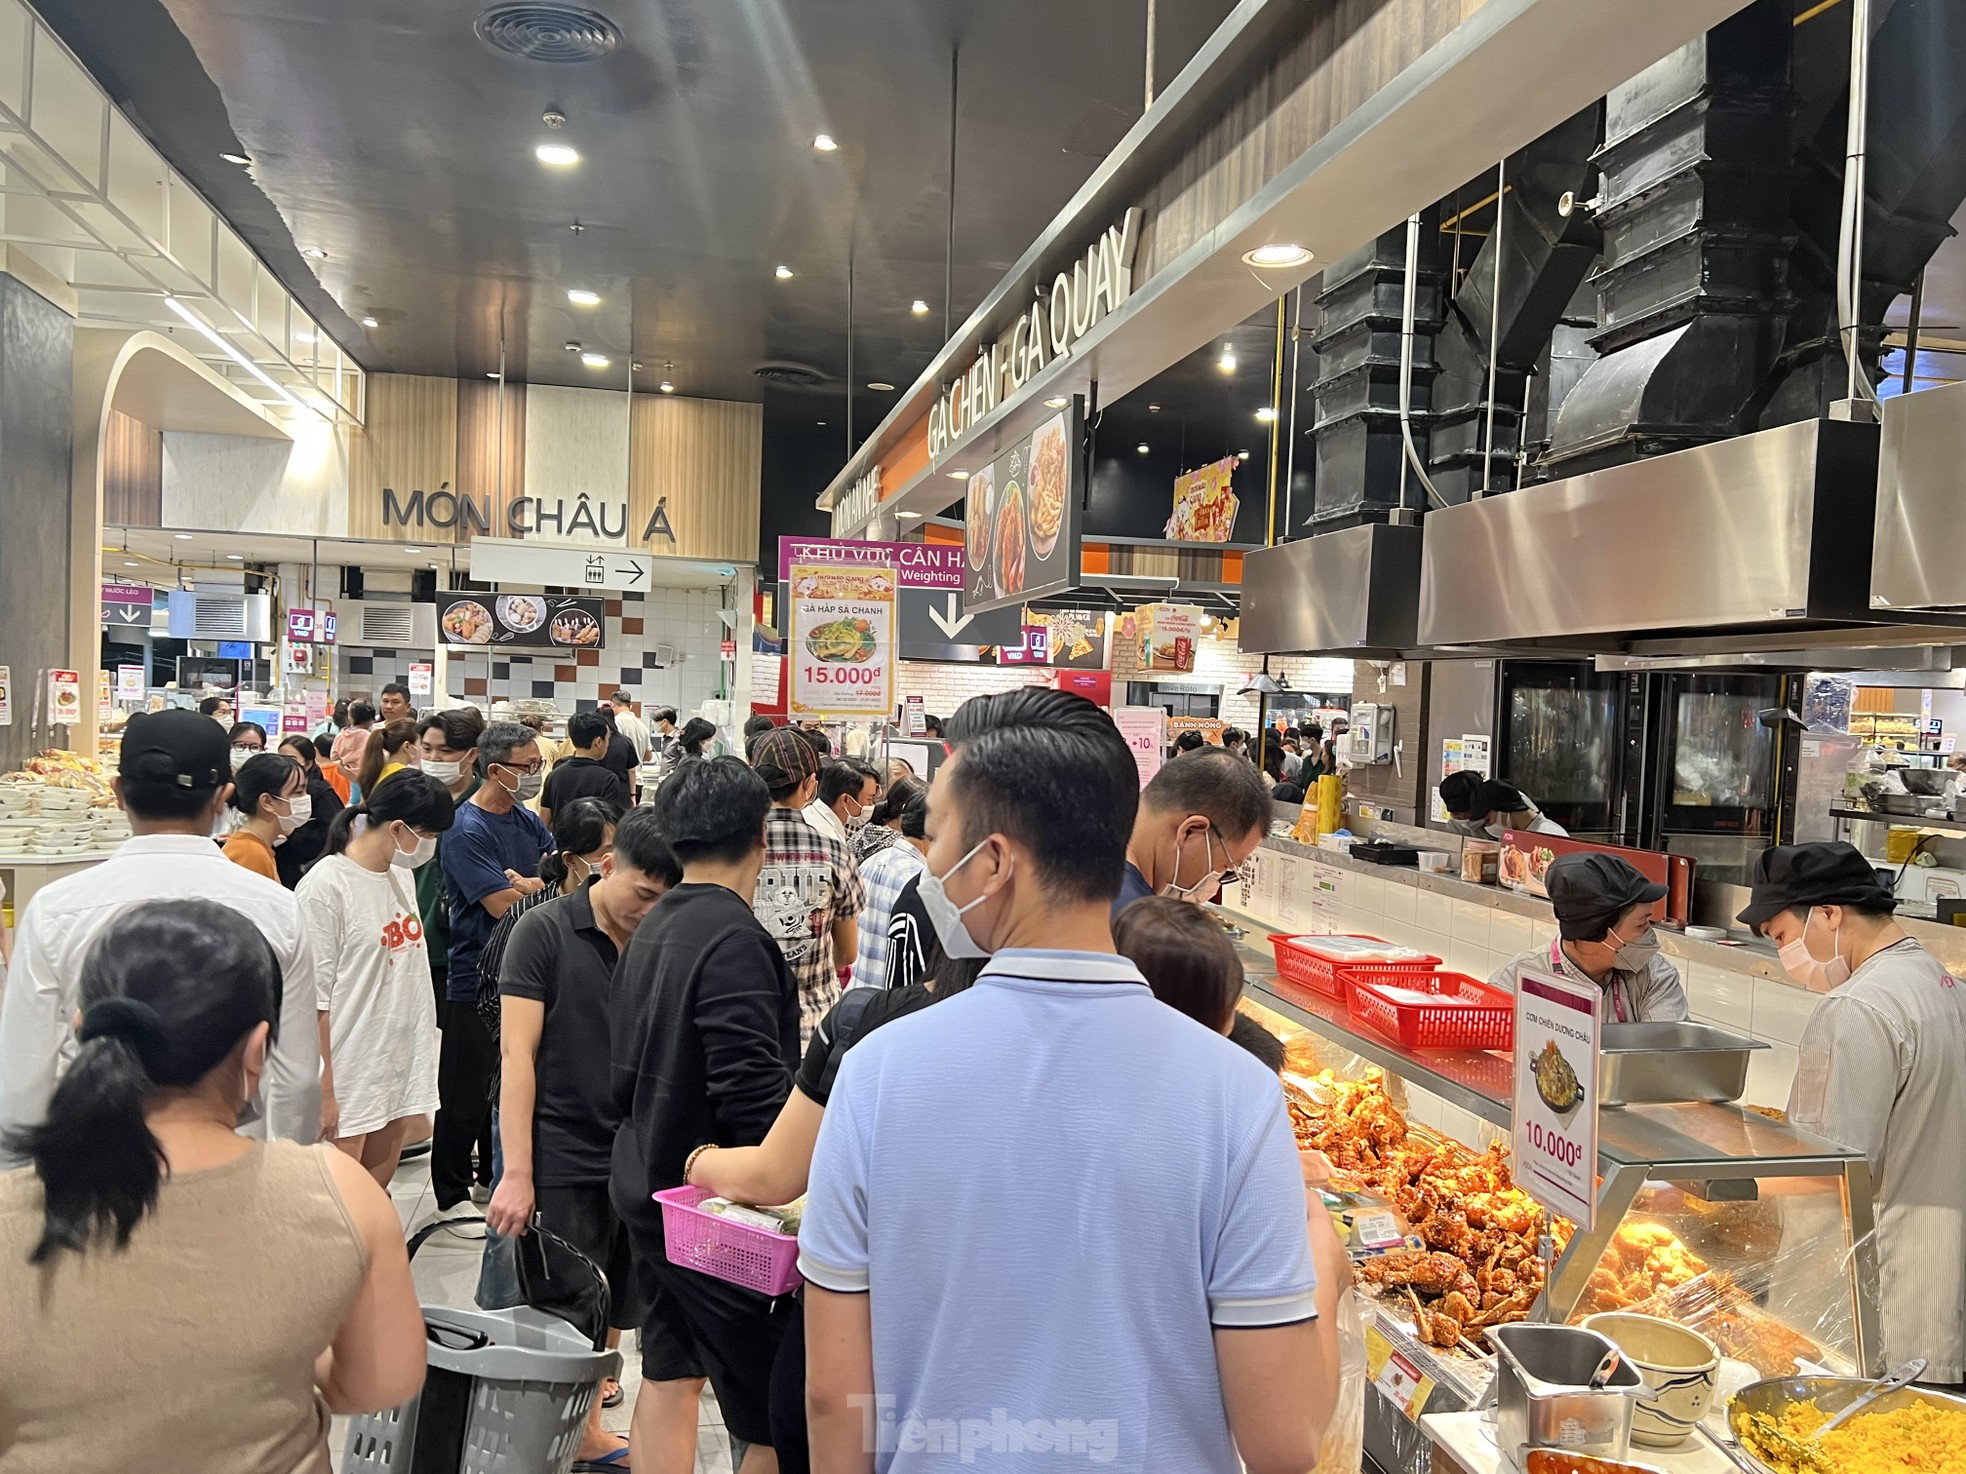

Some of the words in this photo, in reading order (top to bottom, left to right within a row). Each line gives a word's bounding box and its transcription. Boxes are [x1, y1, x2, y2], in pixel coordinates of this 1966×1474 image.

[1011, 285, 1050, 389] GÀ
[1050, 206, 1142, 360] QUAY
[382, 482, 491, 529] MÓN
[507, 492, 627, 539] CHÂU
[643, 496, 677, 543] Á
[900, 546, 941, 567] CÂN
[948, 550, 965, 568] H
[901, 569, 961, 585] Weighting
[851, 607, 883, 615] CHANH
[804, 666, 881, 684] 15.000đ
[1173, 720, 1197, 729] BÁNH
[1525, 1119, 1582, 1168] 10.000đ
